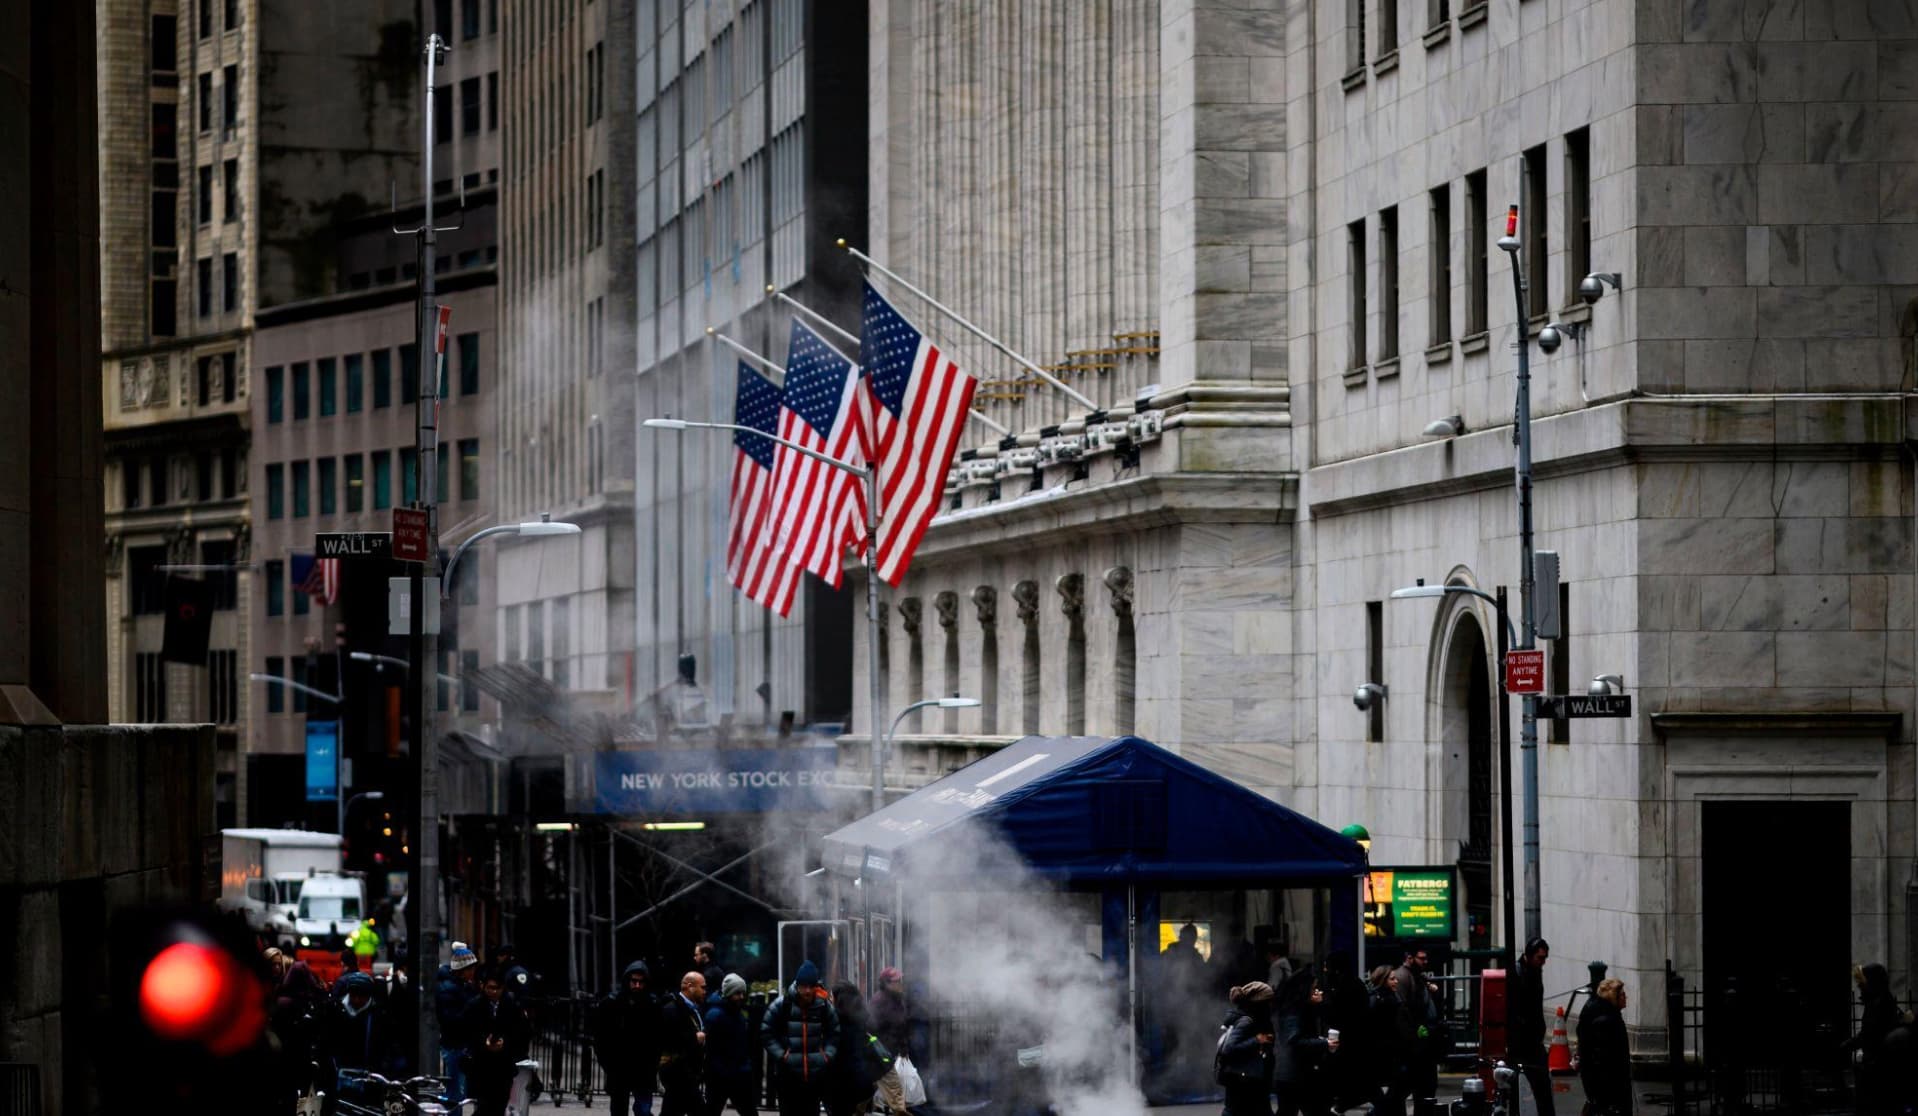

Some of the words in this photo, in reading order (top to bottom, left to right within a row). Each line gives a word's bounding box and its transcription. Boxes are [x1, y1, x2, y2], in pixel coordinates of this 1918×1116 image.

[323, 539, 371, 554] WALL
[371, 539, 384, 547] ST
[1508, 656, 1516, 664] NO
[1518, 654, 1542, 664] STANDING
[1512, 667, 1538, 675] ANYTIME
[1571, 701, 1615, 713] WALL
[621, 773, 664, 789] NEW
[671, 772, 722, 788] YORK
[728, 771, 790, 787] STOCK
